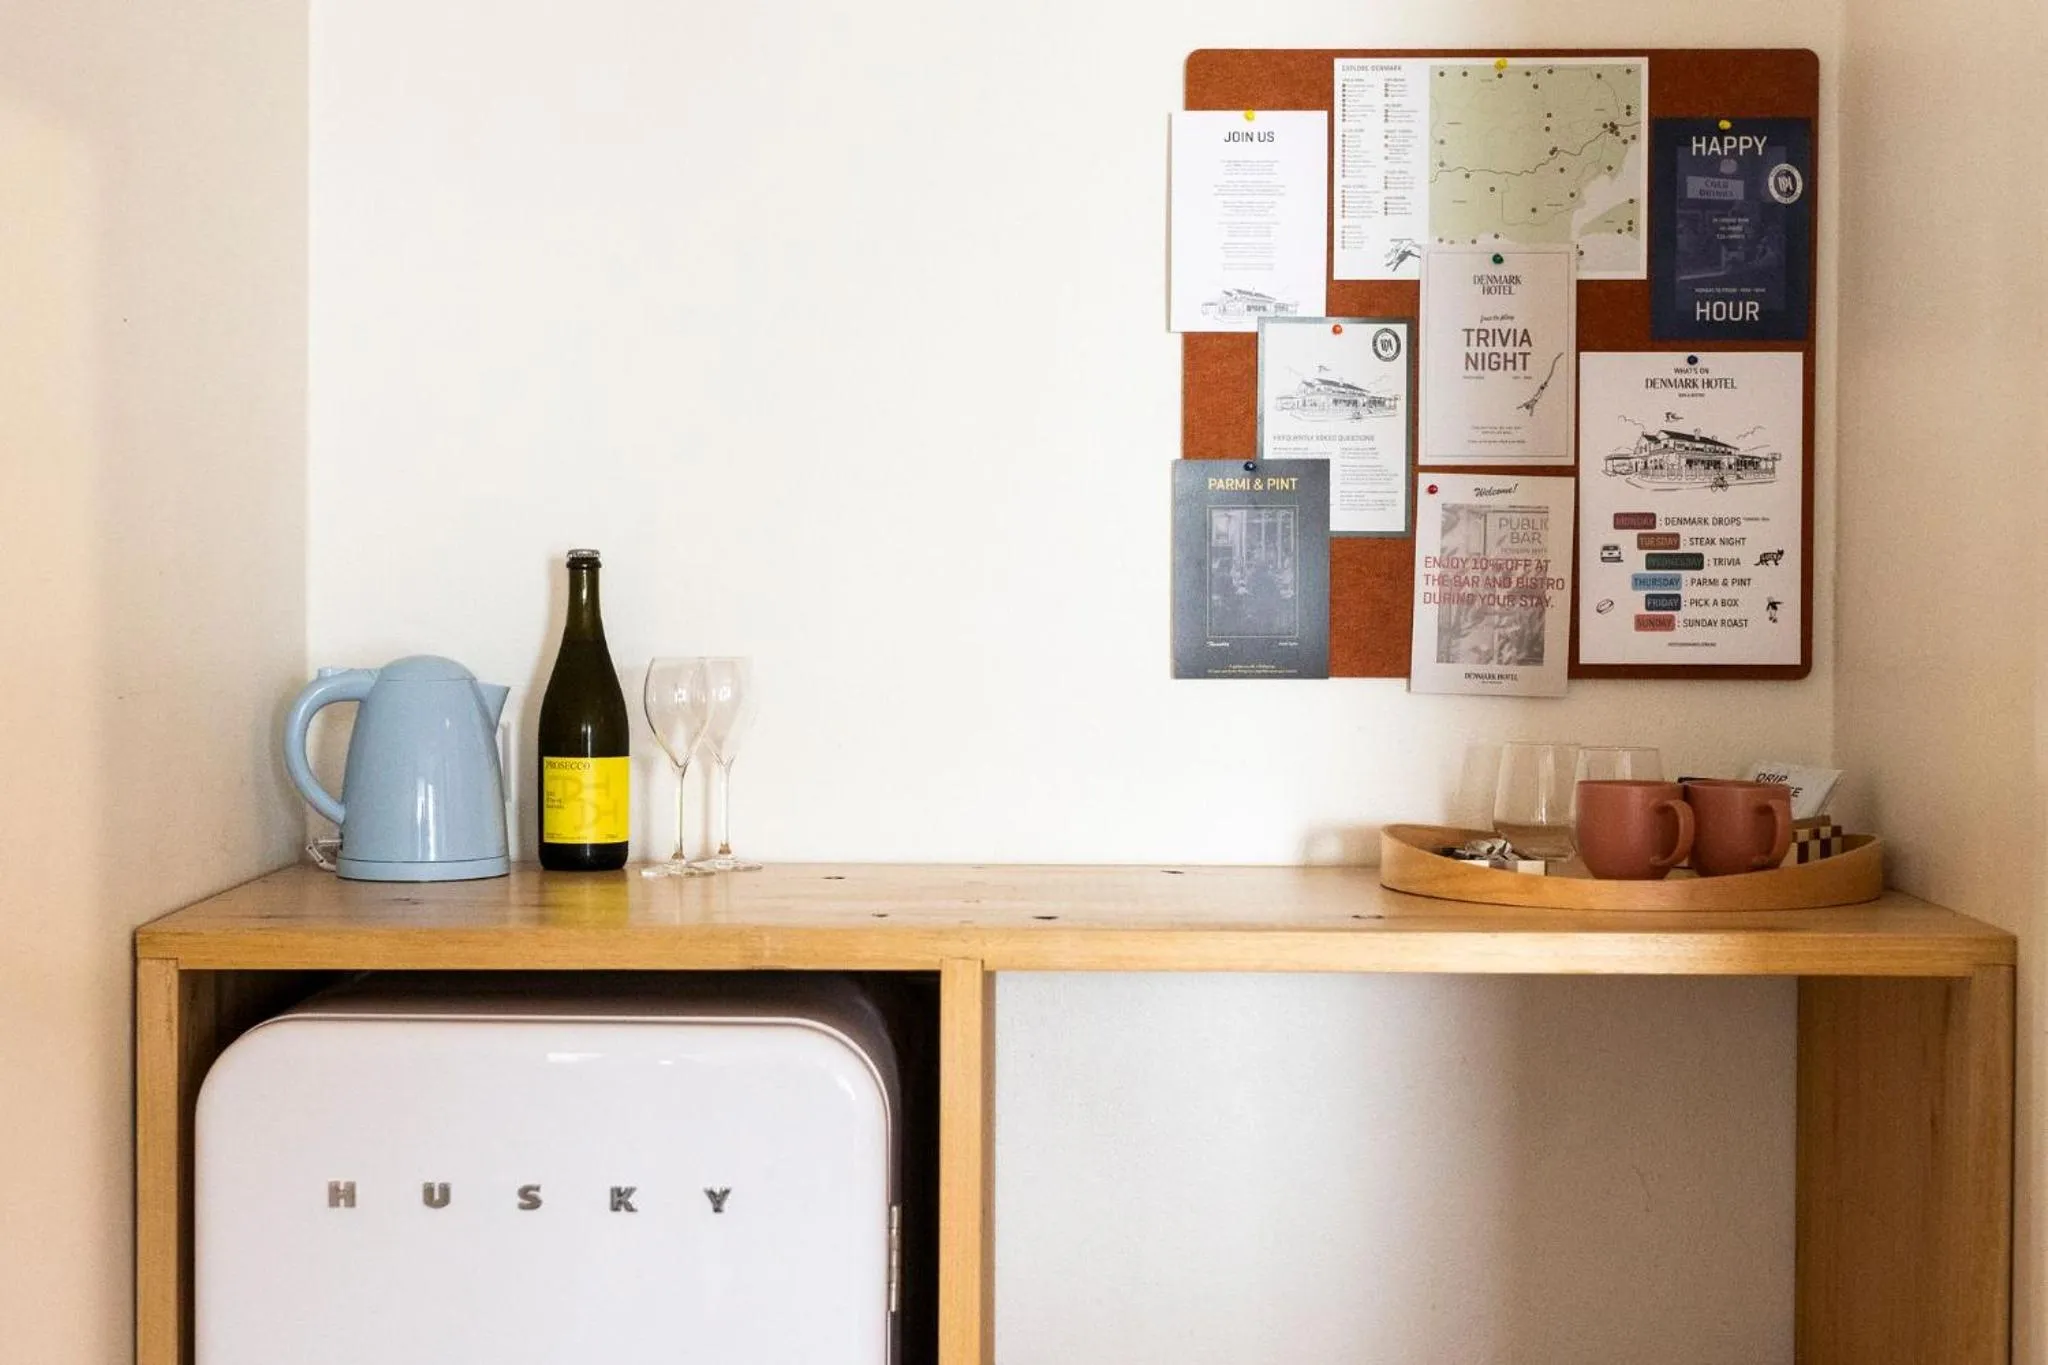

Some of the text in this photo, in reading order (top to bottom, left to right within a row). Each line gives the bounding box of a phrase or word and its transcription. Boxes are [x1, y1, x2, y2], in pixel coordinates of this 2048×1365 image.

[1223, 131, 1275, 143] JOIN US
[1691, 136, 1768, 156] HAPPY
[1473, 274, 1522, 285] DENMARK
[1482, 285, 1516, 295] HOTEL
[1695, 301, 1760, 321] HOUR
[1462, 328, 1532, 347] TRIVIA
[1464, 351, 1531, 371] NIGHT
[1673, 367, 1709, 375] WHAT'S ON
[1645, 377, 1738, 389] DENMARK HOTEL
[1207, 477, 1299, 491] PARMI & PINT
[1474, 483, 1519, 497] Welcome!
[1664, 516, 1709, 527] DENMARK
[1711, 516, 1742, 527] DROPS
[1510, 531, 1542, 544] BAR
[1639, 536, 1678, 547] TUESDAY
[1689, 537, 1716, 546] STEAK
[1719, 537, 1747, 546] NIGHT
[1424, 556, 1468, 570] ENJOY
[1505, 559, 1532, 572] OFF
[1535, 559, 1551, 572] AT
[1713, 557, 1741, 567] TRIVIA
[1423, 574, 1565, 590] THE BAR AND BISTRO
[1634, 578, 1681, 588] THURSDAY
[1691, 578, 1719, 588] PARMI
[1721, 578, 1729, 588] &
[1731, 578, 1752, 588] PINT
[1423, 592, 1554, 609] DURING YOUR STAY.
[1647, 598, 1679, 608] FRIDAY
[1690, 598, 1709, 607] PICK
[1712, 598, 1719, 607] A
[1721, 598, 1740, 607] BOX
[1637, 618, 1672, 629] SUNDAY
[1683, 618, 1718, 628] SUNDAY
[1720, 618, 1749, 628] ROAST
[545, 760, 591, 771] PROSECCO
[1756, 772, 1789, 784] DRIP
